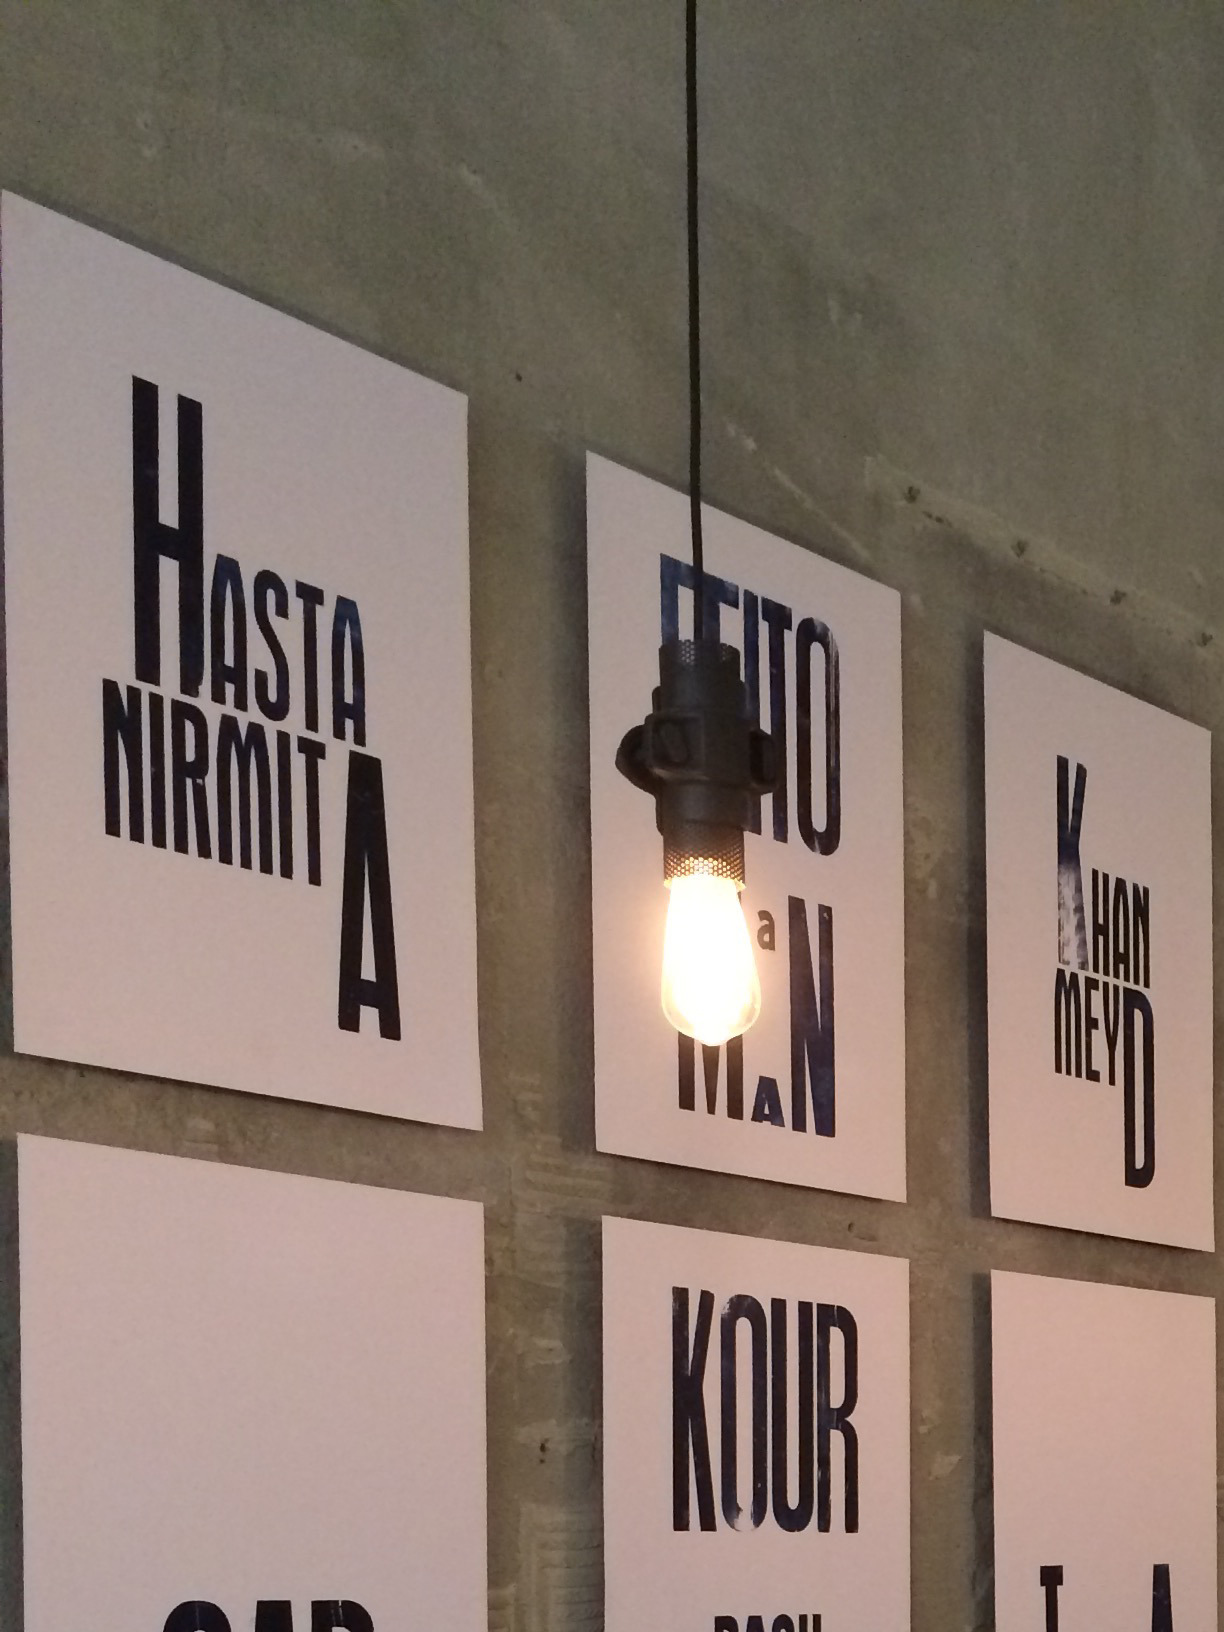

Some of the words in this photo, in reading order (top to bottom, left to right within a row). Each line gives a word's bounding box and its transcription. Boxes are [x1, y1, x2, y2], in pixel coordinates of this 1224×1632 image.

[132, 375, 367, 750] HASTA
[103, 678, 401, 1041] NIRMITA
[757, 909, 776, 951] a
[1055, 754, 1151, 989] KHAN
[1054, 968, 1156, 1189] MEYD
[671, 1286, 859, 1534] KOUR
